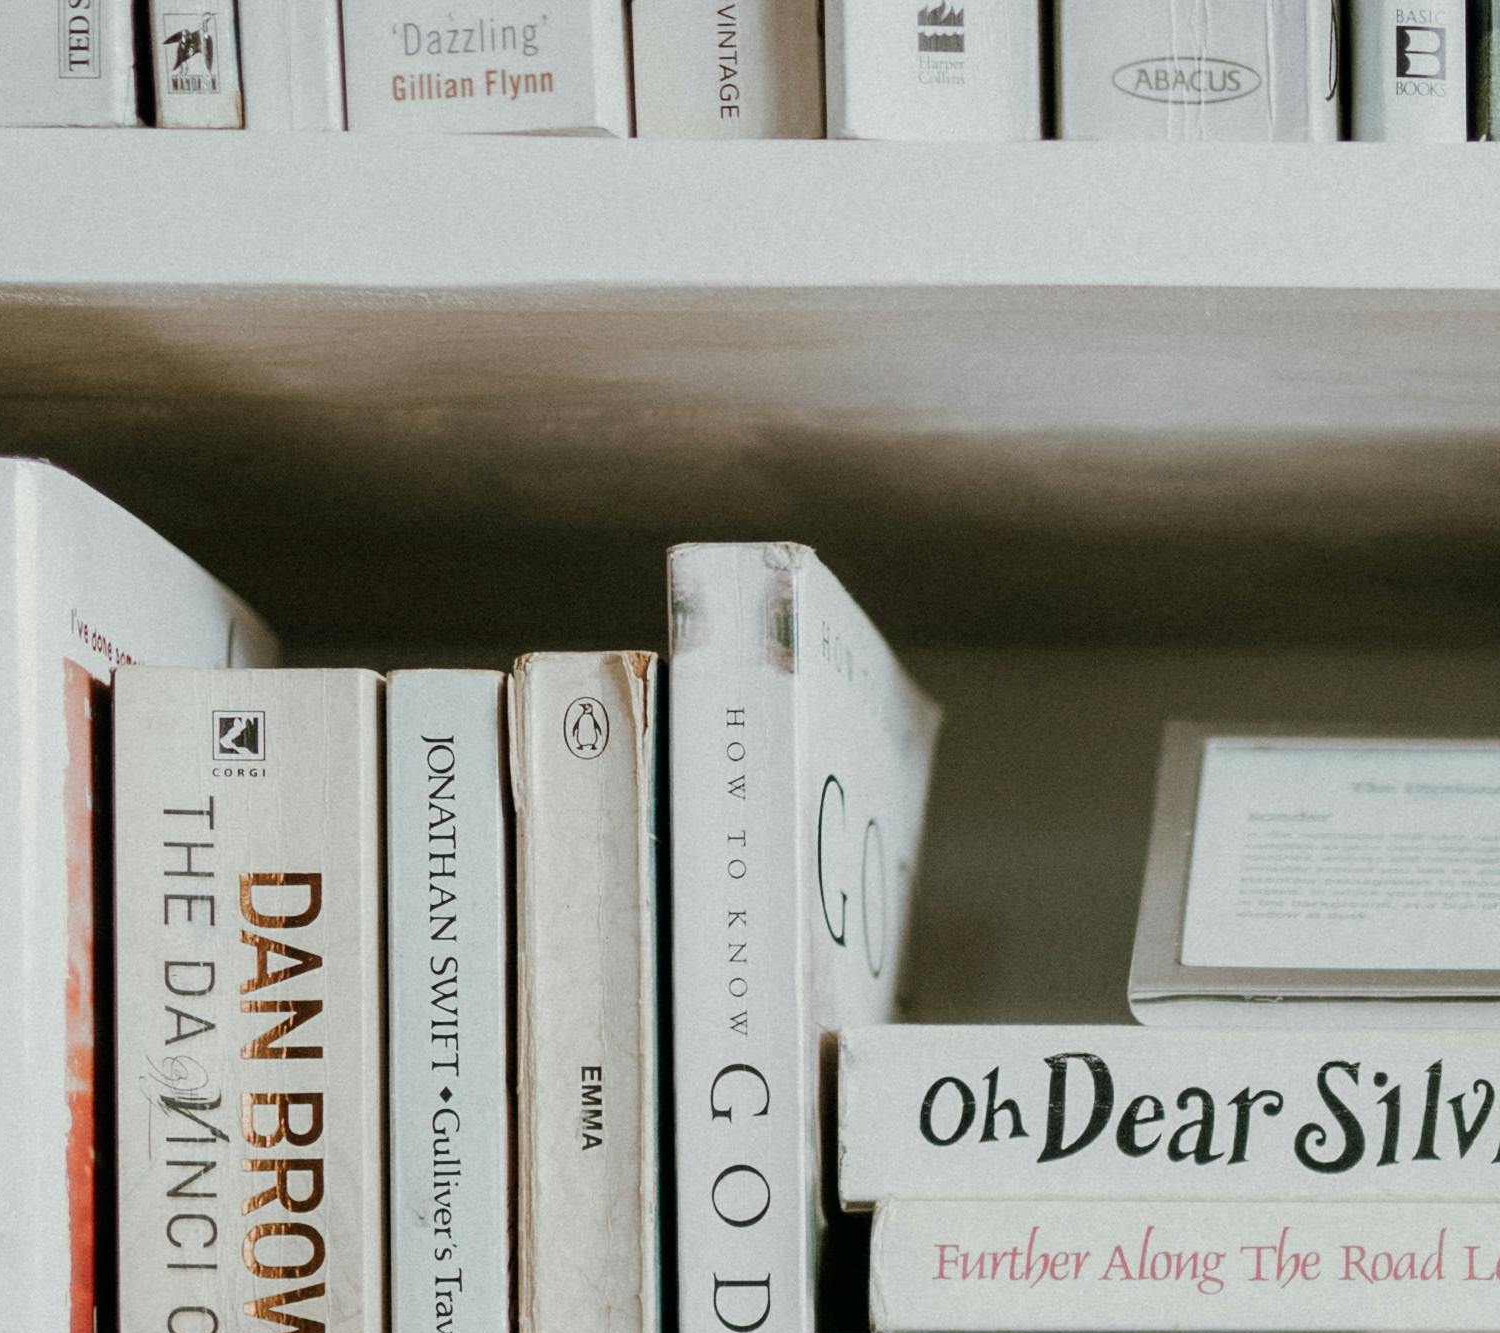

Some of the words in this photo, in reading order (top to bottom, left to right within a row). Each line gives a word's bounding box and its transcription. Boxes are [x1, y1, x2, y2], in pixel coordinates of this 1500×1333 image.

[390, 70, 474, 103] Gillian
[485, 66, 555, 108] Flynn
[1132, 66, 1242, 95] ABACUS
[726, 706, 747, 801] HOW
[421, 734, 458, 942] JONATHAN
[727, 831, 747, 880] TO
[239, 872, 323, 1059] DAN
[429, 956, 460, 1078] SWIFT
[727, 909, 748, 1036] KNOW
[580, 1066, 602, 1151] EMMA
[919, 1066, 1029, 1147] Oh
[1037, 1052, 1284, 1164] Dear
[430, 1108, 462, 1262] Gulliver's
[709, 1062, 771, 1332] GOD
[933, 1226, 1091, 1291] Further
[1102, 1226, 1226, 1294] Along
[1241, 1226, 1321, 1290] The
[1340, 1227, 1447, 1285] Road
